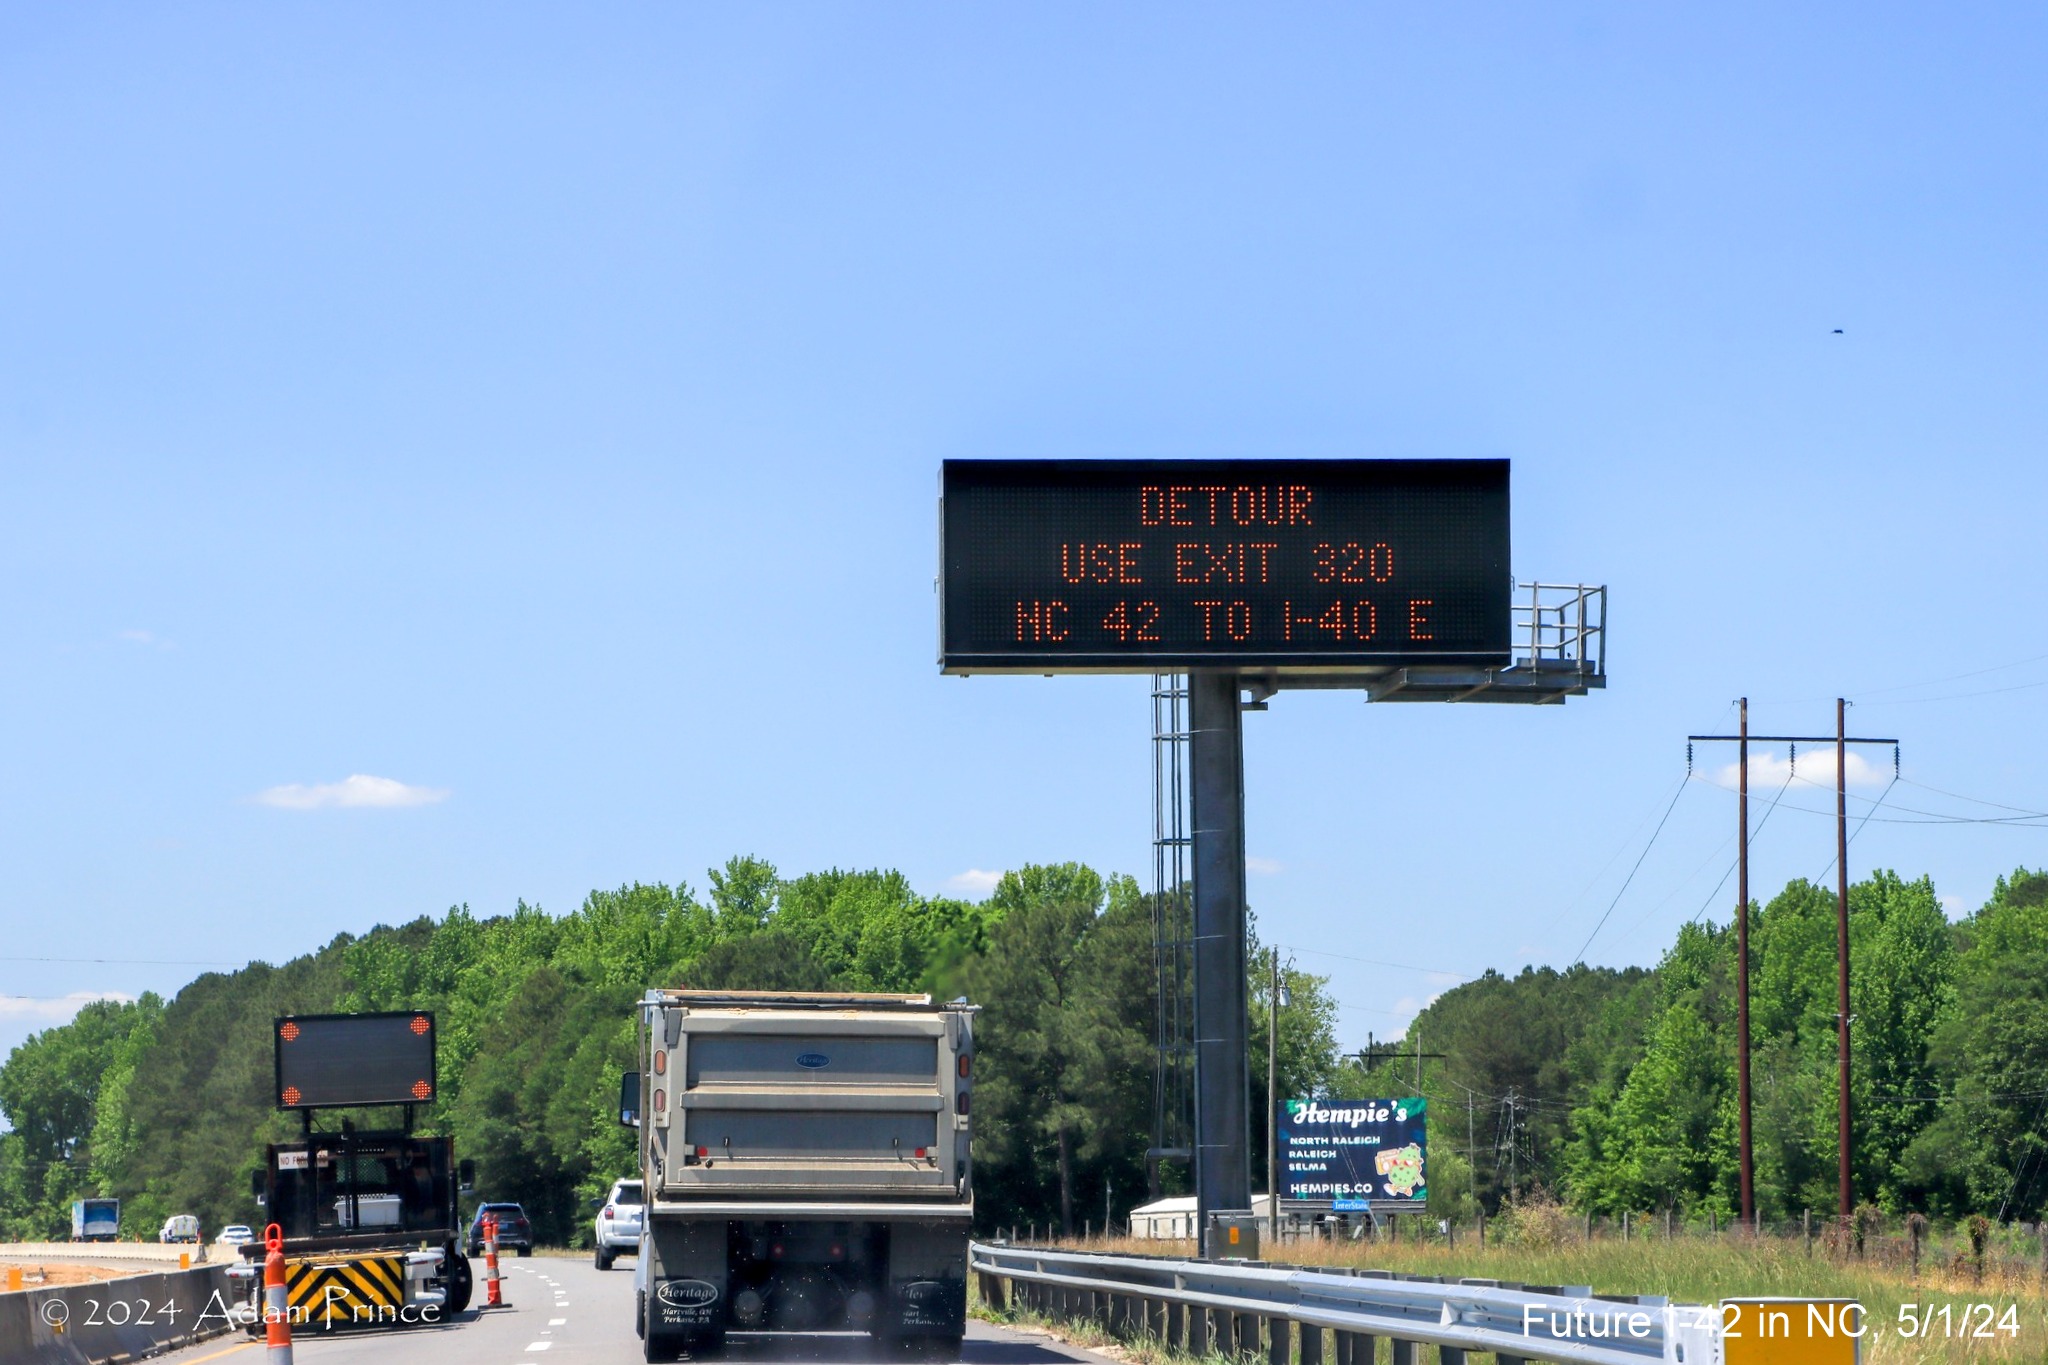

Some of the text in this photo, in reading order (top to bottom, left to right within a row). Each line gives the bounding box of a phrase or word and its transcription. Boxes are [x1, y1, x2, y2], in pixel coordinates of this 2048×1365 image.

[1142, 485, 1312, 525] DETOUR
[1062, 543, 1393, 584] USE EXIT 320
[1017, 600, 1433, 641] NC 42 TO I-40 E
[1293, 1100, 1408, 1128] Hempie's
[1290, 1136, 1381, 1145] NORTH RALEIGH
[1288, 1149, 1337, 1159] RALEIGH
[1288, 1162, 1327, 1172] SELMA
[1290, 1183, 1373, 1194] HEMPIES.CO
[661, 1287, 715, 1300] Heritage
